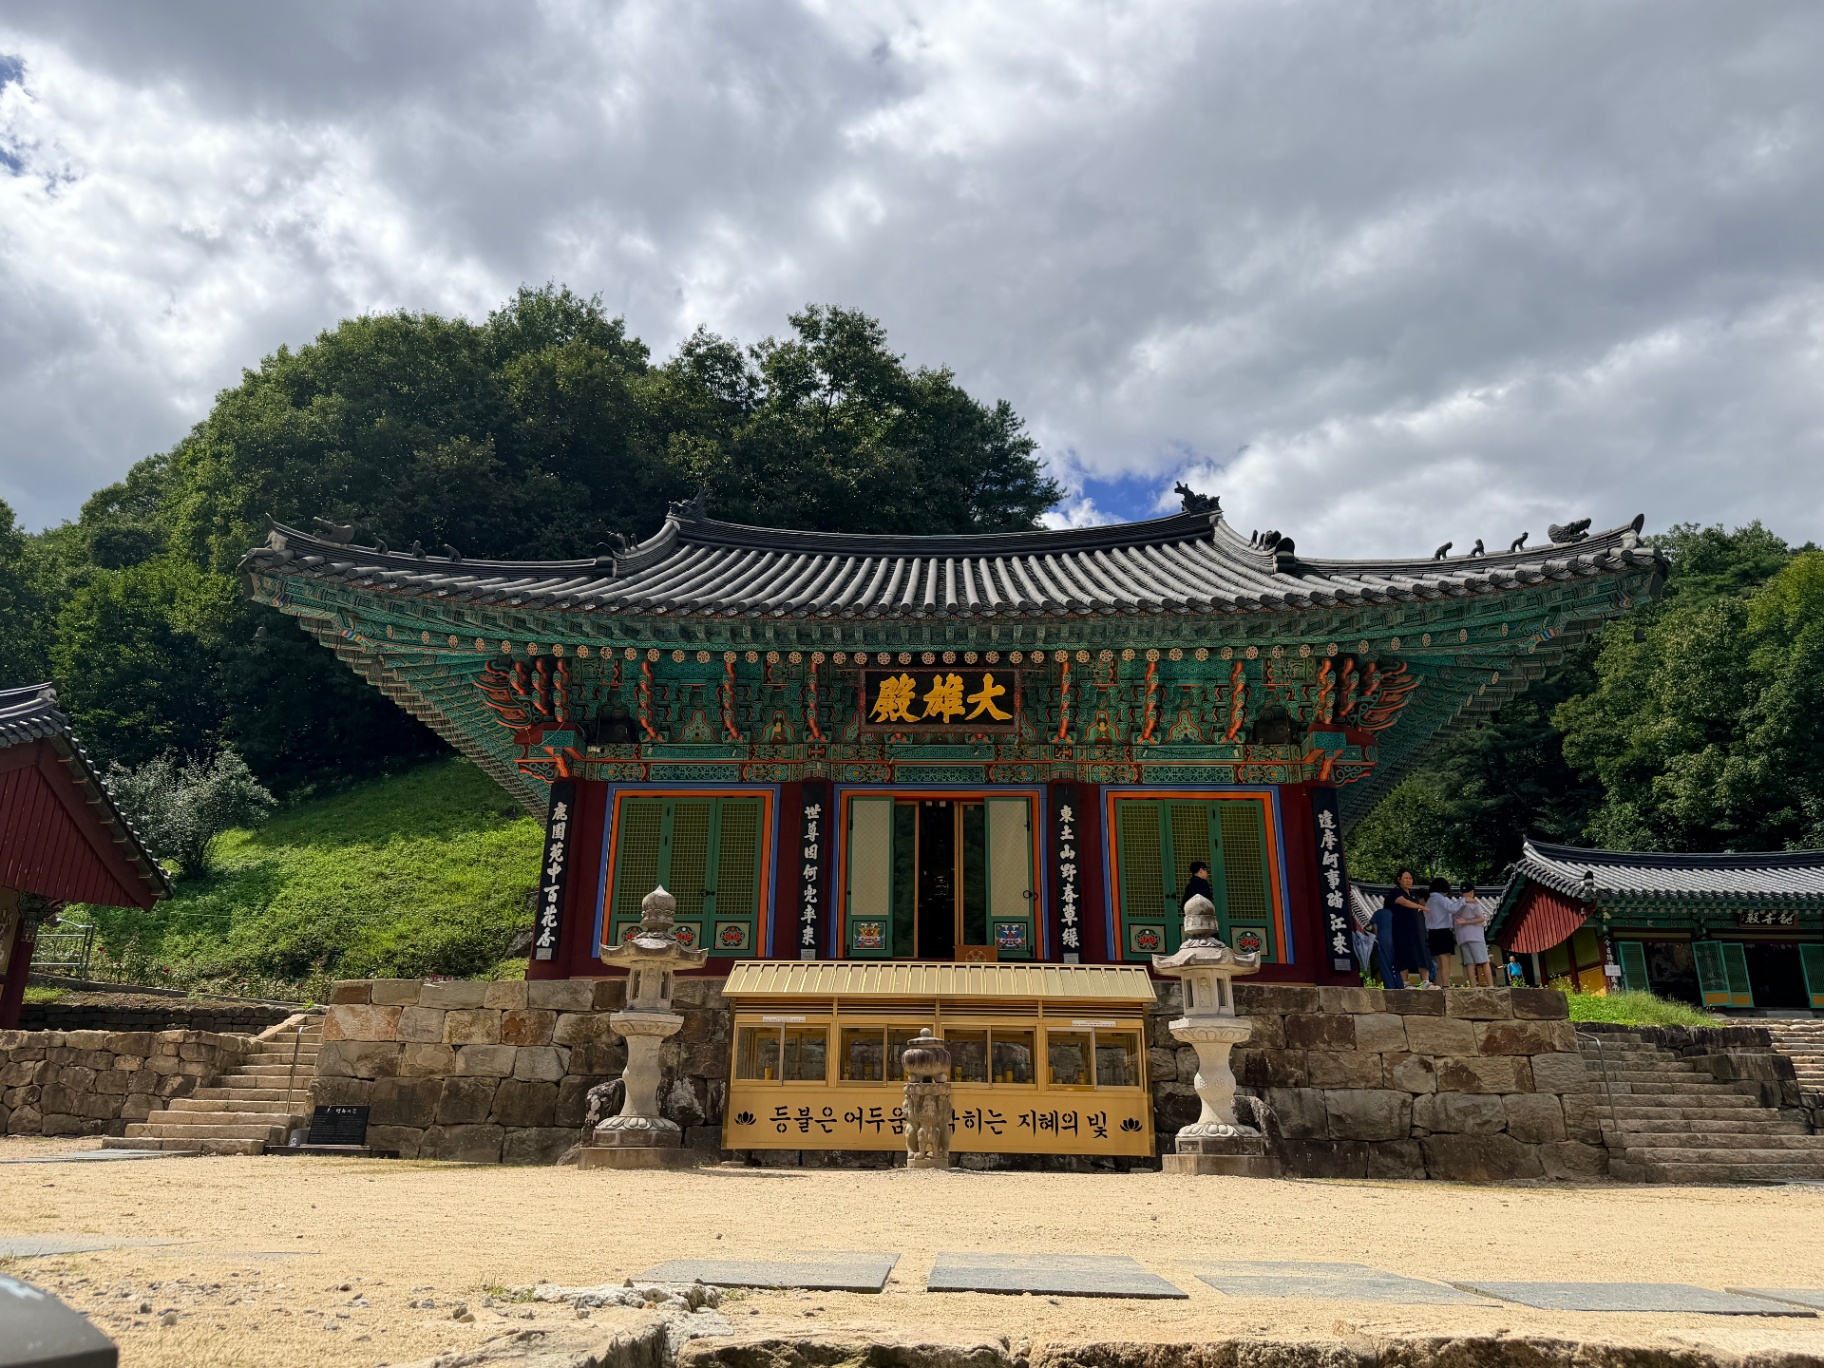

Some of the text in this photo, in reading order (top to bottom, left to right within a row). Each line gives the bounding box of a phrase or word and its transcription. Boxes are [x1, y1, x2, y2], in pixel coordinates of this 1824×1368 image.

[868, 672, 1013, 723] 大雄殿
[769, 1105, 838, 1134] 등불은
[844, 1106, 908, 1135] 어두움
[1017, 1109, 1078, 1138] 지혜의
[1086, 1111, 1108, 1139] 빛
